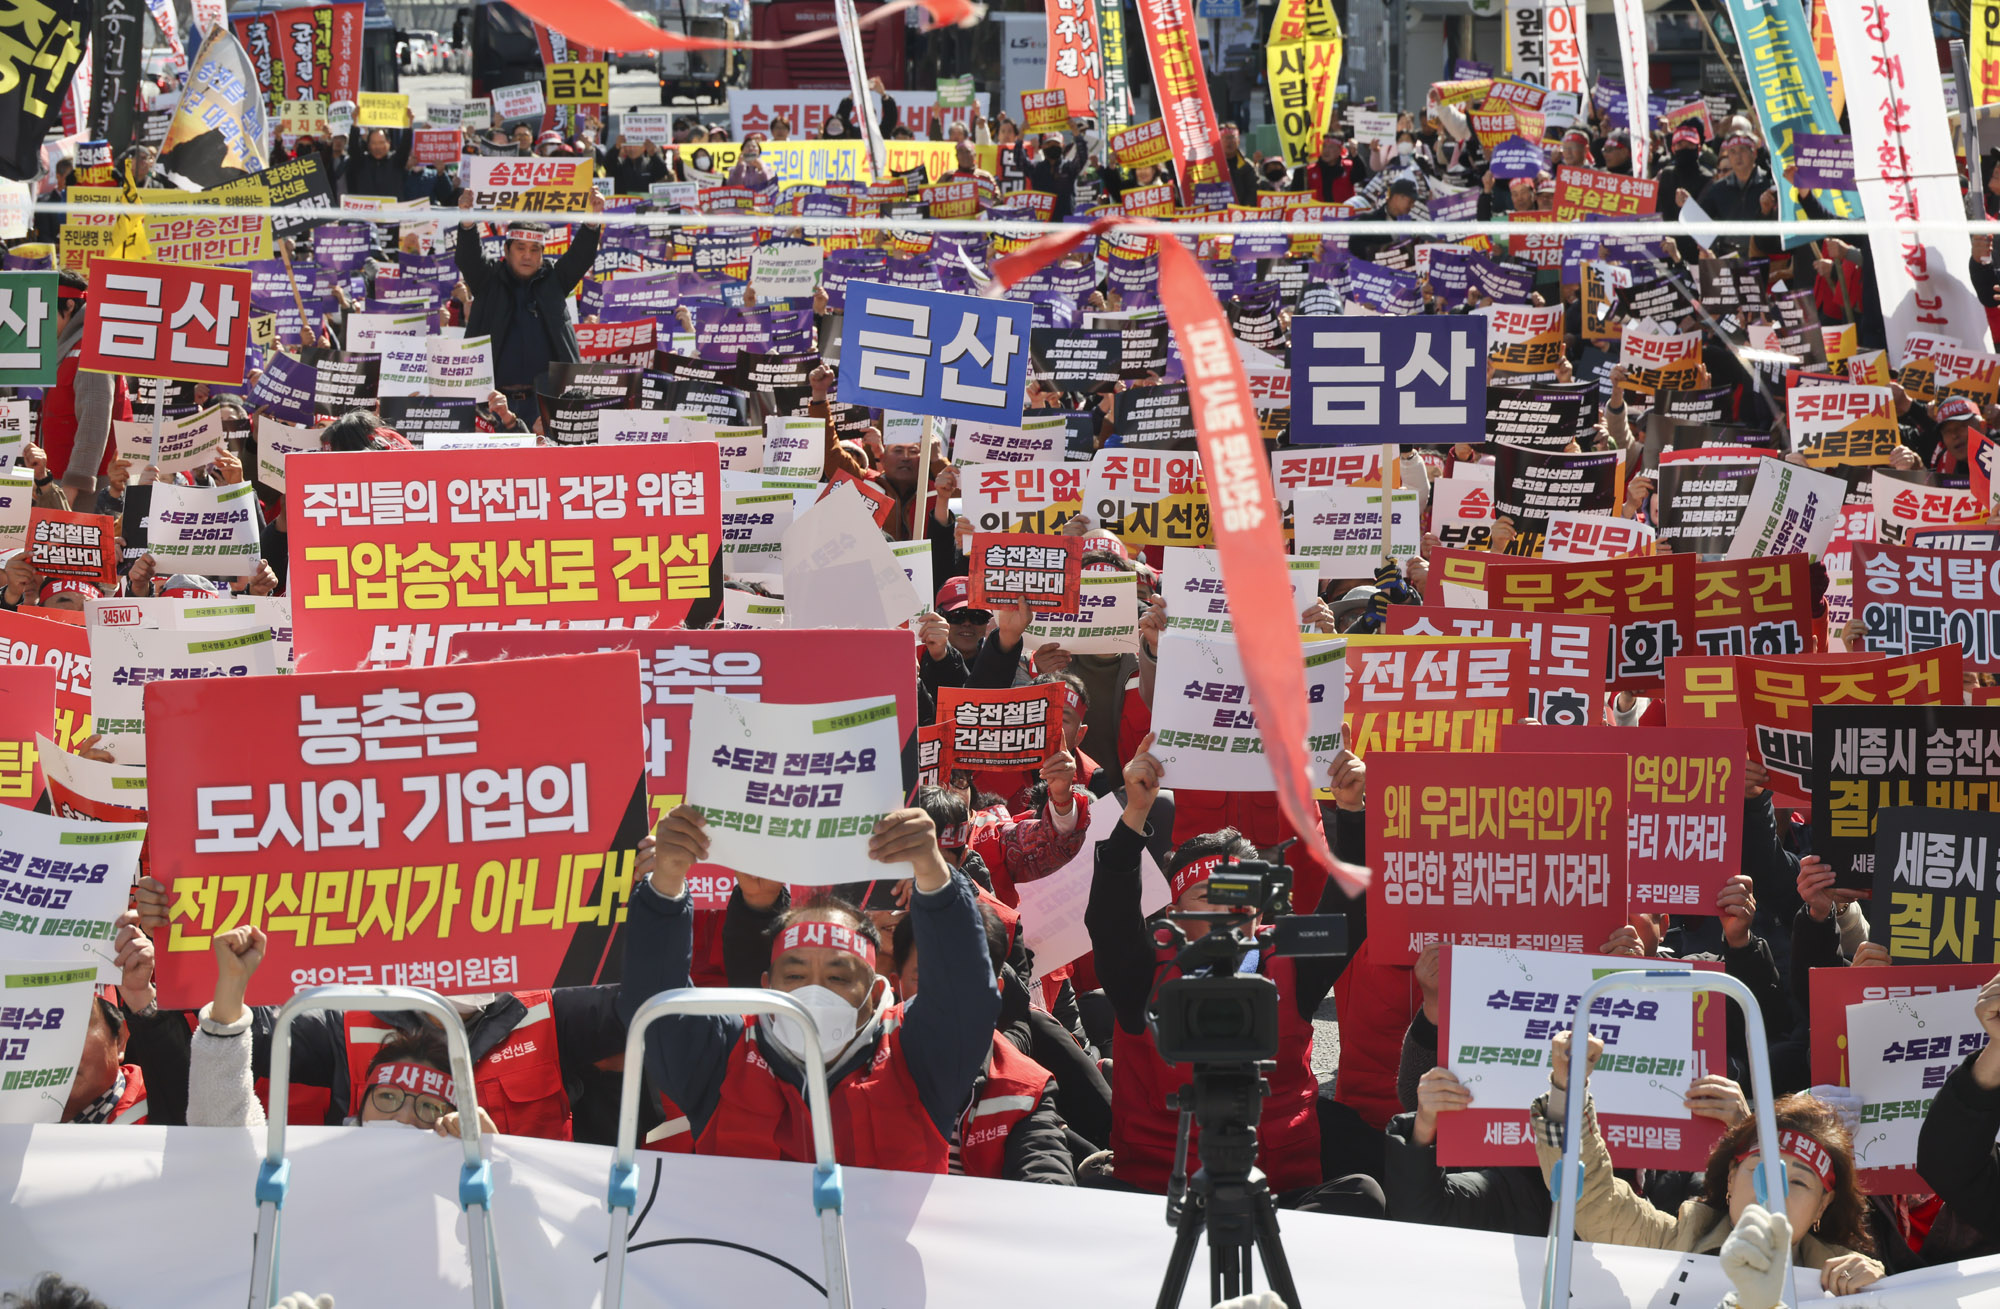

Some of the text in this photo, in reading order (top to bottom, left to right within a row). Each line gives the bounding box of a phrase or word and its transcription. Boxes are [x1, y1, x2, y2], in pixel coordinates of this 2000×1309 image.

[552, 69, 604, 98] 금산
[1489, 84, 1542, 107] 송전선로
[1024, 94, 1066, 108] 송전선로
[1112, 126, 1162, 149] 송전선로
[489, 162, 576, 186] 송전선로
[809, 149, 855, 181] 에너지
[921, 188, 975, 204] 송전선로
[1125, 188, 1173, 207] 송전선로
[1564, 186, 1639, 214] 목숨걸고
[1596, 175, 1618, 188] 고압
[1620, 181, 1654, 198] 송전탑
[150, 215, 264, 241] 고압송전탑
[157, 236, 260, 262] 반대한다!
[98, 273, 240, 368] 금산
[1492, 309, 1563, 336] 주민무시
[576, 327, 652, 349] 우회경로
[1624, 335, 1699, 362] 주민무시
[858, 297, 1019, 408] 금산
[1308, 331, 1476, 426] 금산
[1626, 363, 1699, 391] 선로결정
[1794, 393, 1891, 422] 주민무시
[970, 431, 1053, 451] 수도권 전력수요
[1798, 428, 1897, 459] 선로결정
[303, 471, 705, 527] 주민들의 안전과 건강 위협
[159, 509, 249, 525] 수도권 전력수요
[1312, 512, 1350, 526] 수도권
[34, 520, 101, 546] 송전철탑
[179, 528, 234, 541] 분산하고
[32, 544, 103, 568] 건설반대
[985, 544, 1068, 570] 송전철탑
[304, 533, 711, 610] 고압송전선로 건설
[983, 569, 1065, 595] 건설반대
[1503, 563, 1675, 614] 무조건
[102, 608, 132, 626] 345kV
[1183, 680, 1244, 705] 수도권
[1754, 658, 1942, 719] 무조건
[298, 688, 479, 765] 농촌은
[954, 699, 1048, 728] 송전철탑
[953, 725, 1046, 753] 건설반대
[1830, 727, 1916, 775] 세종시
[712, 744, 877, 776] 수도권 전력수요
[1628, 755, 1732, 805] 역인가?
[195, 762, 590, 853] 도시와 기업의
[745, 780, 844, 808] 분산하고
[767, 811, 811, 839] 절차
[1383, 785, 1613, 841] 왜 우리지역인가?
[1664, 813, 1727, 862] 지켜라
[24, 857, 109, 884] 전력수요
[1893, 831, 1988, 892] 세종시
[1383, 851, 1612, 907] 정당한 절차부터 지켜라
[168, 849, 637, 953] 전기식민지가 아니다!
[1636, 884, 1700, 905] 주민일동
[0, 911, 39, 935] 절차
[1889, 892, 1983, 963] 결사
[784, 922, 868, 957] 결사반대
[1515, 934, 1584, 953] 주민일동
[381, 955, 519, 990] 대책위원회
[1486, 989, 1559, 1014] 수도권
[489, 1040, 537, 1064] 송전선로
[1458, 1045, 1685, 1078] 민주적인 마련하라!
[1882, 1036, 1952, 1063] 수도권
[2, 1067, 74, 1091] 마련하라!
[965, 1124, 1009, 1147] 송전선로
[1607, 1124, 1682, 1150] 주민일동
